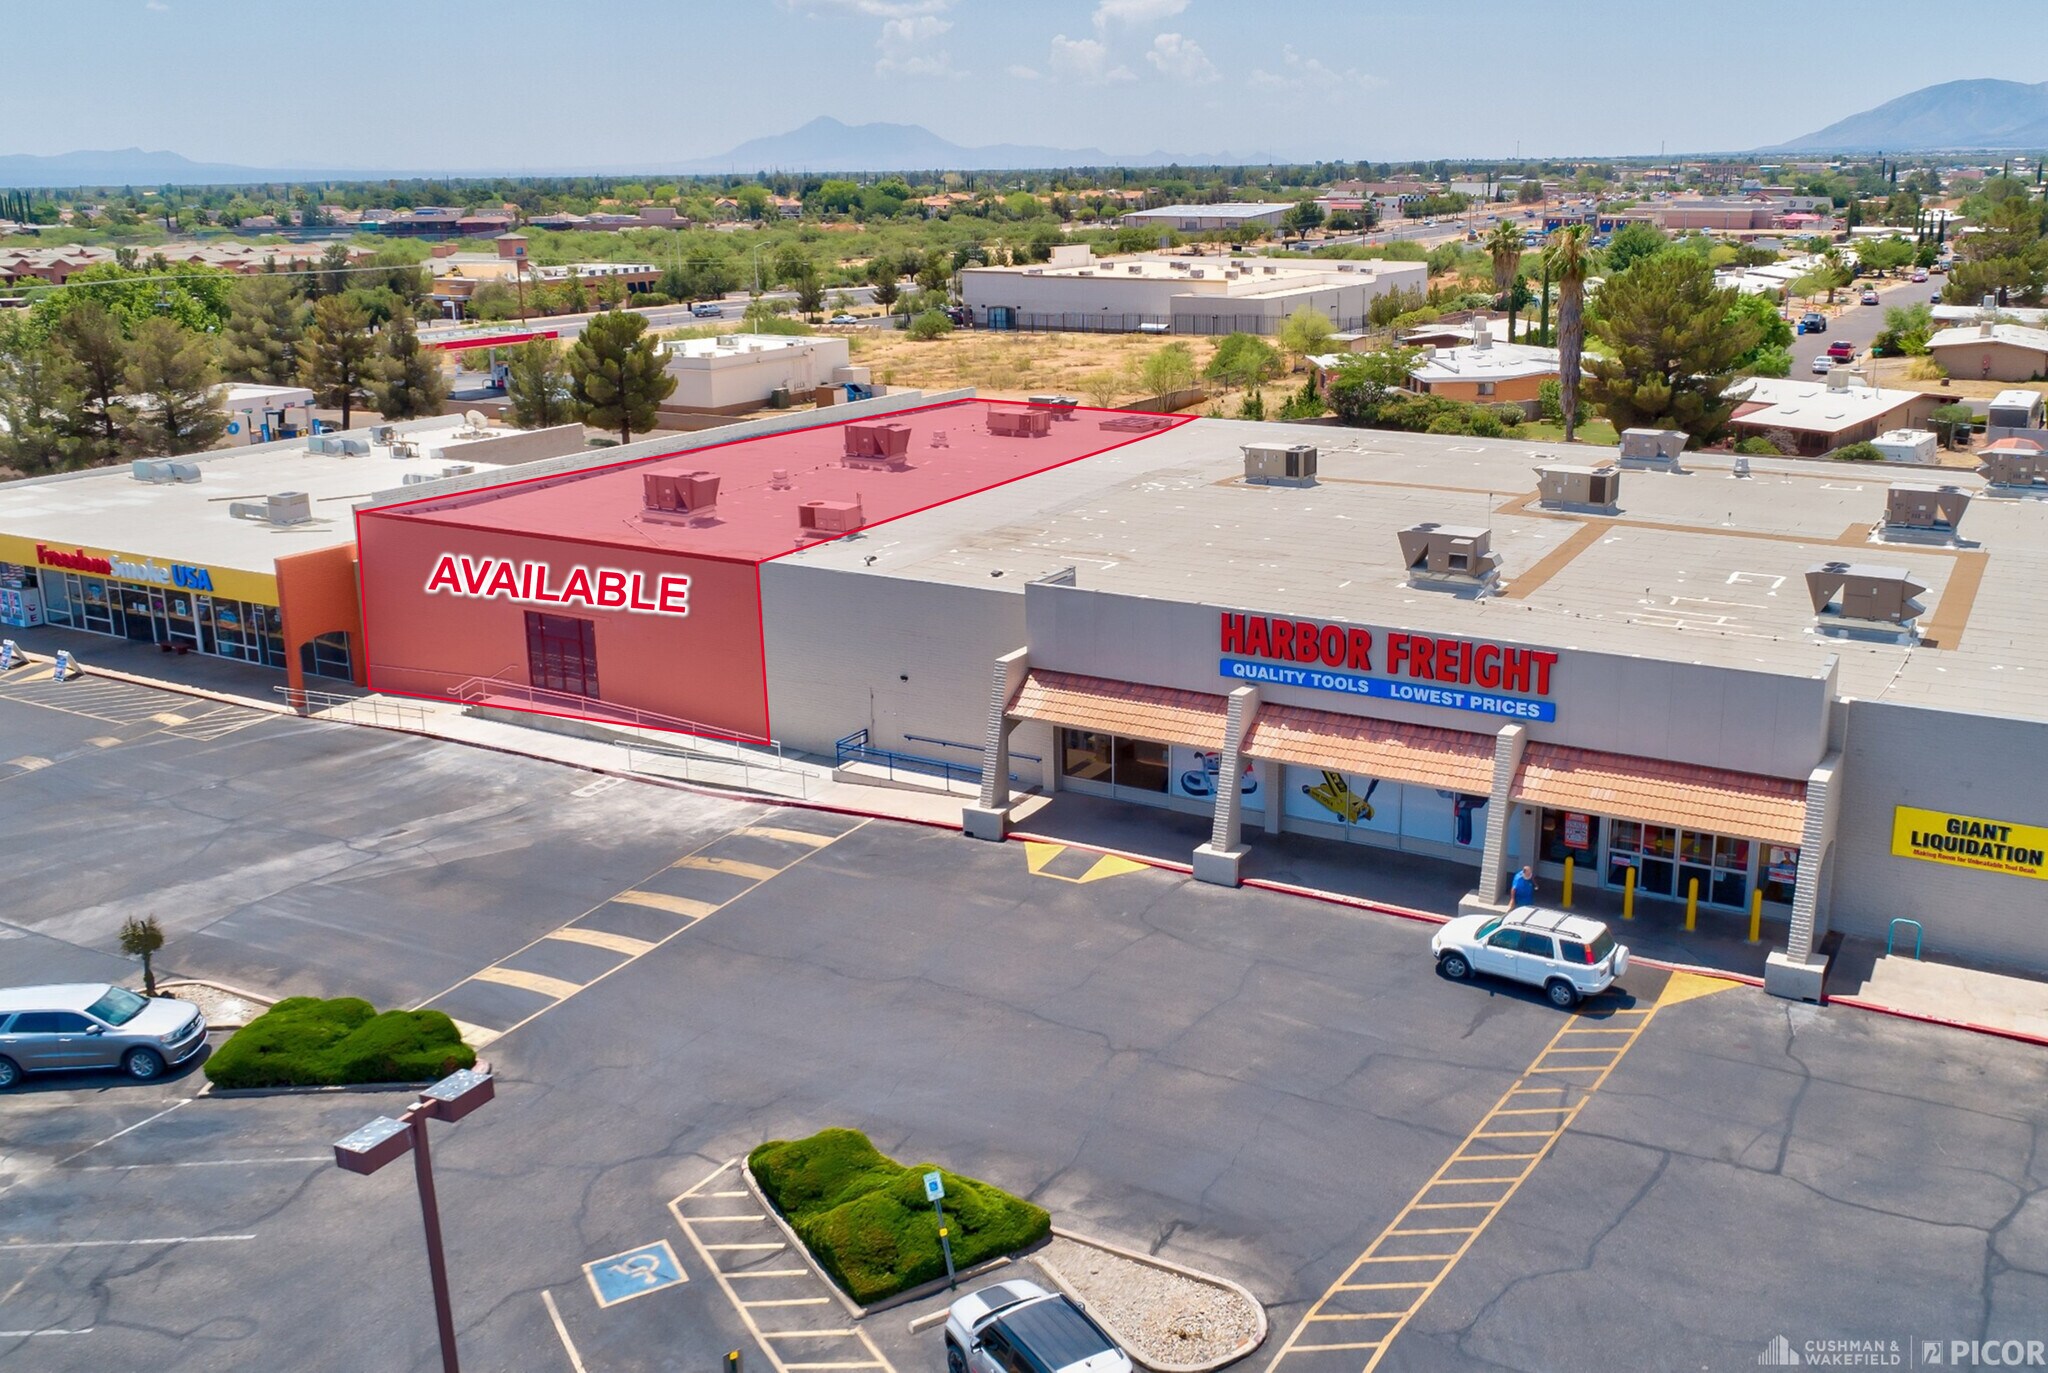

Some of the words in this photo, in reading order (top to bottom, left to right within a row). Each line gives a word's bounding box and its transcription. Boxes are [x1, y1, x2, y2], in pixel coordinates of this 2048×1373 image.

[171, 563, 213, 592] USA
[1220, 611, 1372, 671] HARBOR
[1386, 632, 1558, 695] FREIGHT
[1232, 663, 1306, 684] QUALITY
[1311, 673, 1369, 693] TOOLS
[1390, 684, 1464, 707] LOWEST
[1469, 695, 1540, 718] PRICES
[1910, 830, 2045, 867] LIQUIDATION
[1946, 818, 2011, 842] GIANT
